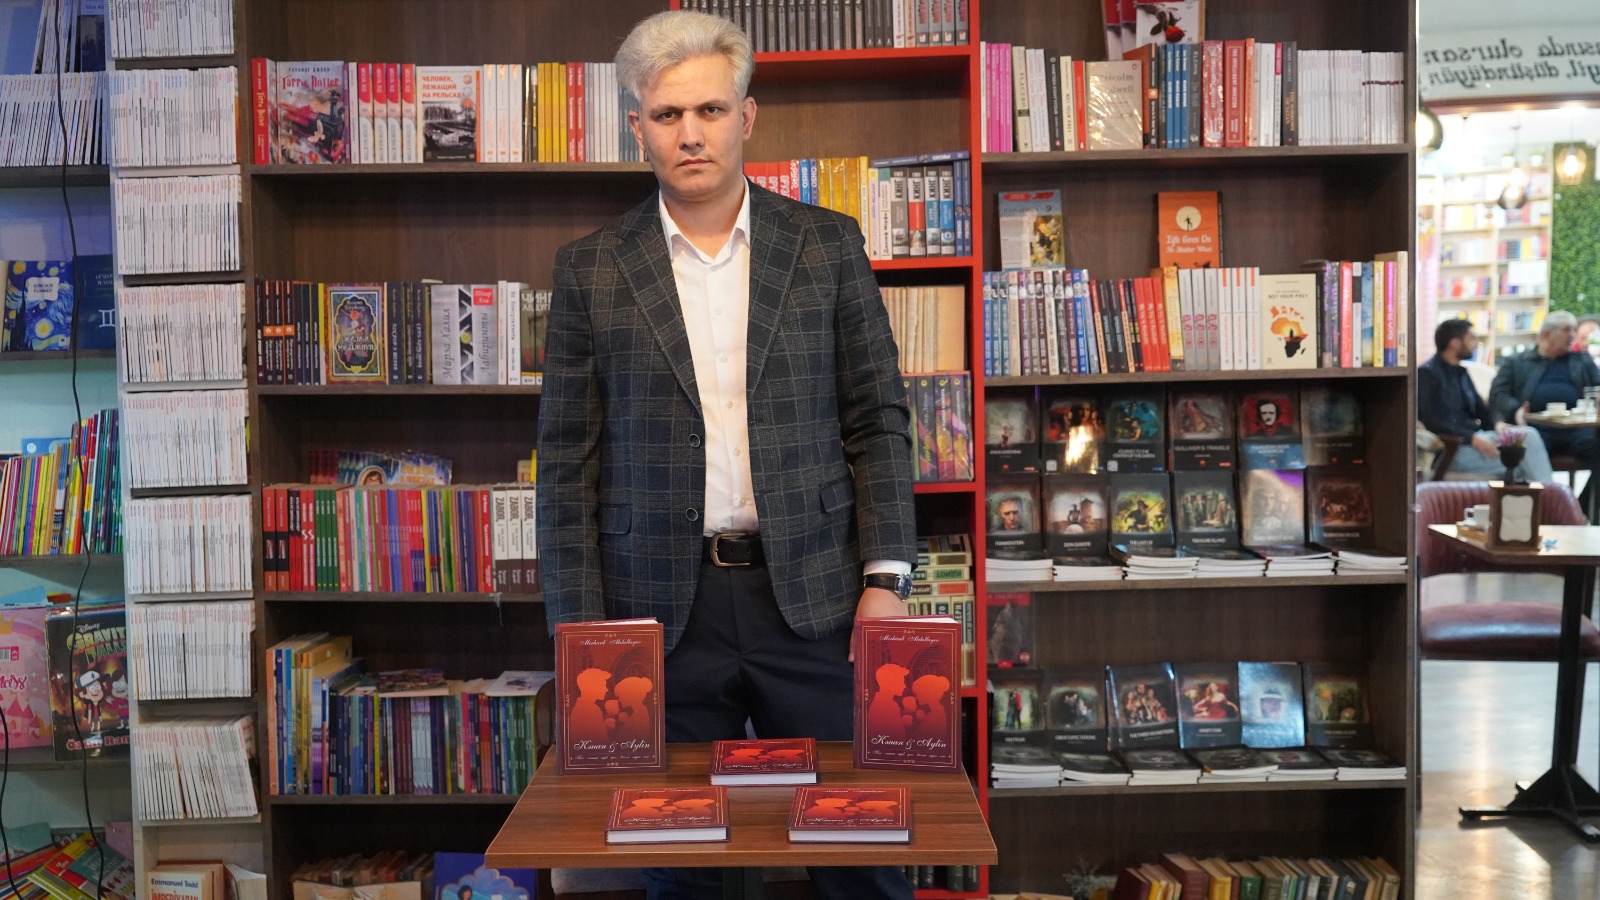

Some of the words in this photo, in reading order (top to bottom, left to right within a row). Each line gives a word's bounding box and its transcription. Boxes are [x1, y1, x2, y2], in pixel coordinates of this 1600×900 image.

[422, 83, 457, 91] ЛЕЖАЩИЙ
[895, 179, 904, 198] КИНГ
[912, 180, 921, 199] КИНГ
[928, 179, 936, 198] КИНГ
[942, 179, 951, 198] КИНГ
[1166, 235, 1180, 246] Life
[441, 308, 451, 341] Халил
[479, 312, 492, 375] Лабиринты
[442, 343, 454, 378] Мирза
[66, 627, 127, 651] GRAVIT
[620, 739, 650, 753] Aylin
[917, 737, 947, 750] Aylin
[151, 878, 183, 887] Emmanuel
[185, 880, 199, 889] Todd
